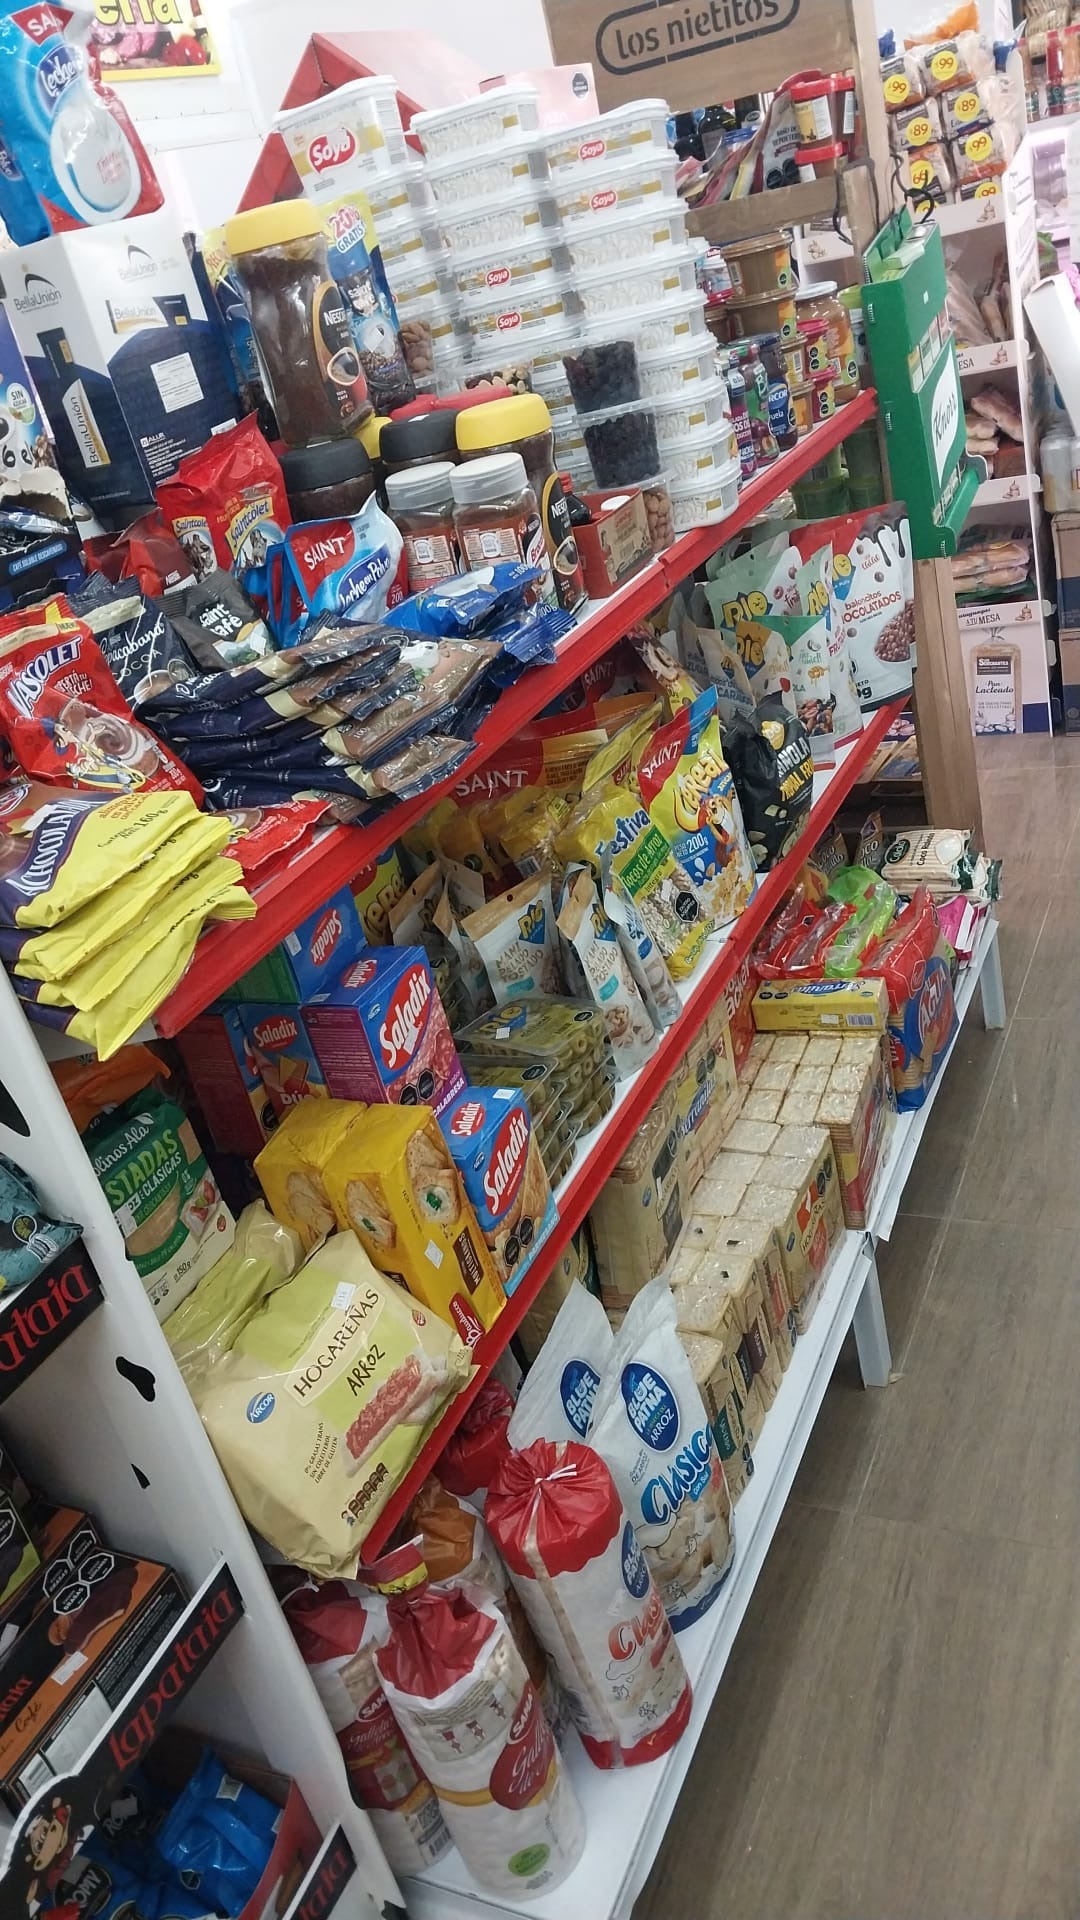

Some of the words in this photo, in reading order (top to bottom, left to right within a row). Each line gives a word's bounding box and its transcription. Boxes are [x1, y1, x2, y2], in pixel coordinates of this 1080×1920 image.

[616, 26, 660, 60] los
[667, 0, 779, 46] nietitos
[580, 141, 603, 159] Soya
[591, 193, 615, 210] Soya
[487, 268, 509, 286] Soya
[498, 313, 520, 329] Soya
[303, 536, 347, 571] SAINT
[723, 590, 767, 628] RIO
[7, 635, 83, 720] VASCOLET
[975, 686, 1014, 694] Lacteado
[641, 740, 682, 779] SAINT
[456, 769, 528, 798] SAINT
[253, 1017, 299, 1048] Saladix
[378, 969, 432, 1069] Saladix
[126, 1124, 151, 1150] Ala
[451, 1102, 481, 1136] Saladix
[483, 1112, 529, 1215] Saladix
[346, 1343, 386, 1396] ARROZ
[250, 1392, 275, 1423] ARCOR
[566, 1370, 595, 1417] BLUE
[627, 1372, 657, 1420] BLUE
[634, 1385, 668, 1435] PATNA
[649, 1407, 675, 1446] ARROZ
[107, 1588, 236, 1771] Lapataia
